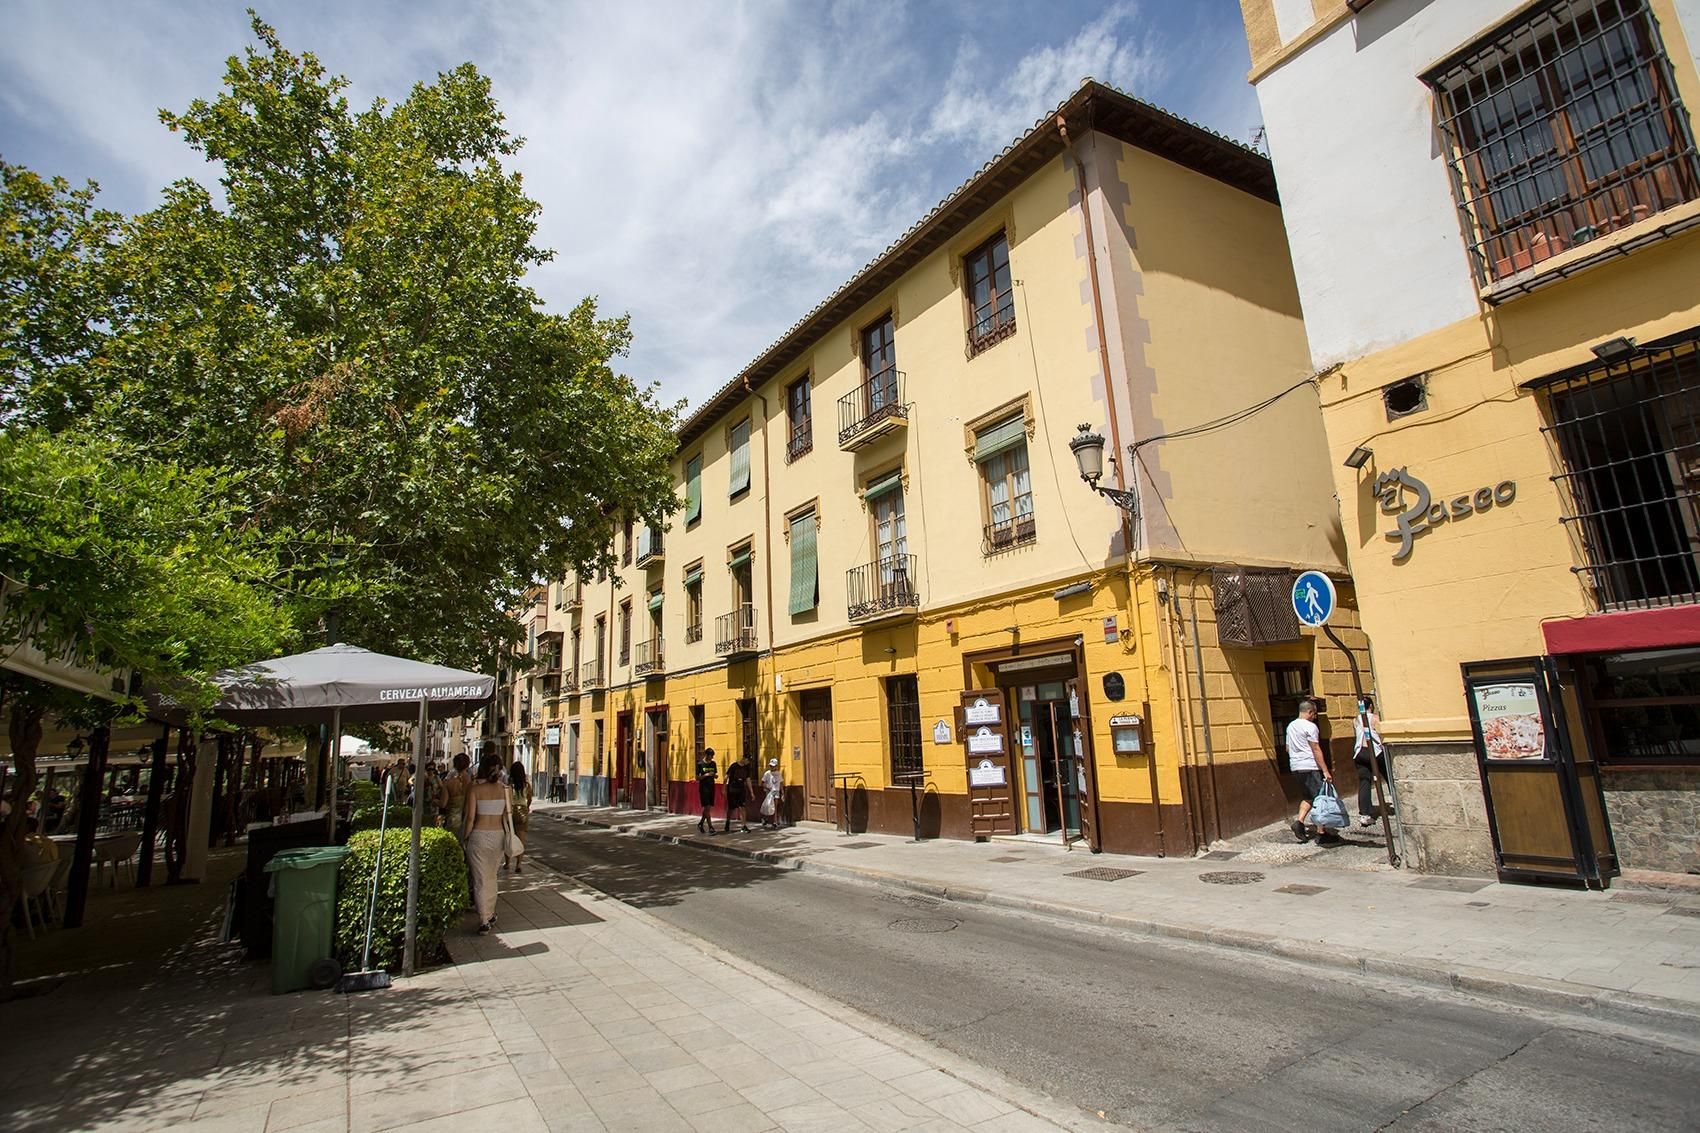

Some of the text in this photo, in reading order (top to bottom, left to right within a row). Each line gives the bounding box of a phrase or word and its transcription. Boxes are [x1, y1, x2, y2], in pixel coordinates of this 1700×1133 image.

[1374, 465, 1516, 560] Paseo
[380, 686, 482, 701] CERVEZAS ALHAMBRA
[1482, 703, 1507, 712] Pizzas
